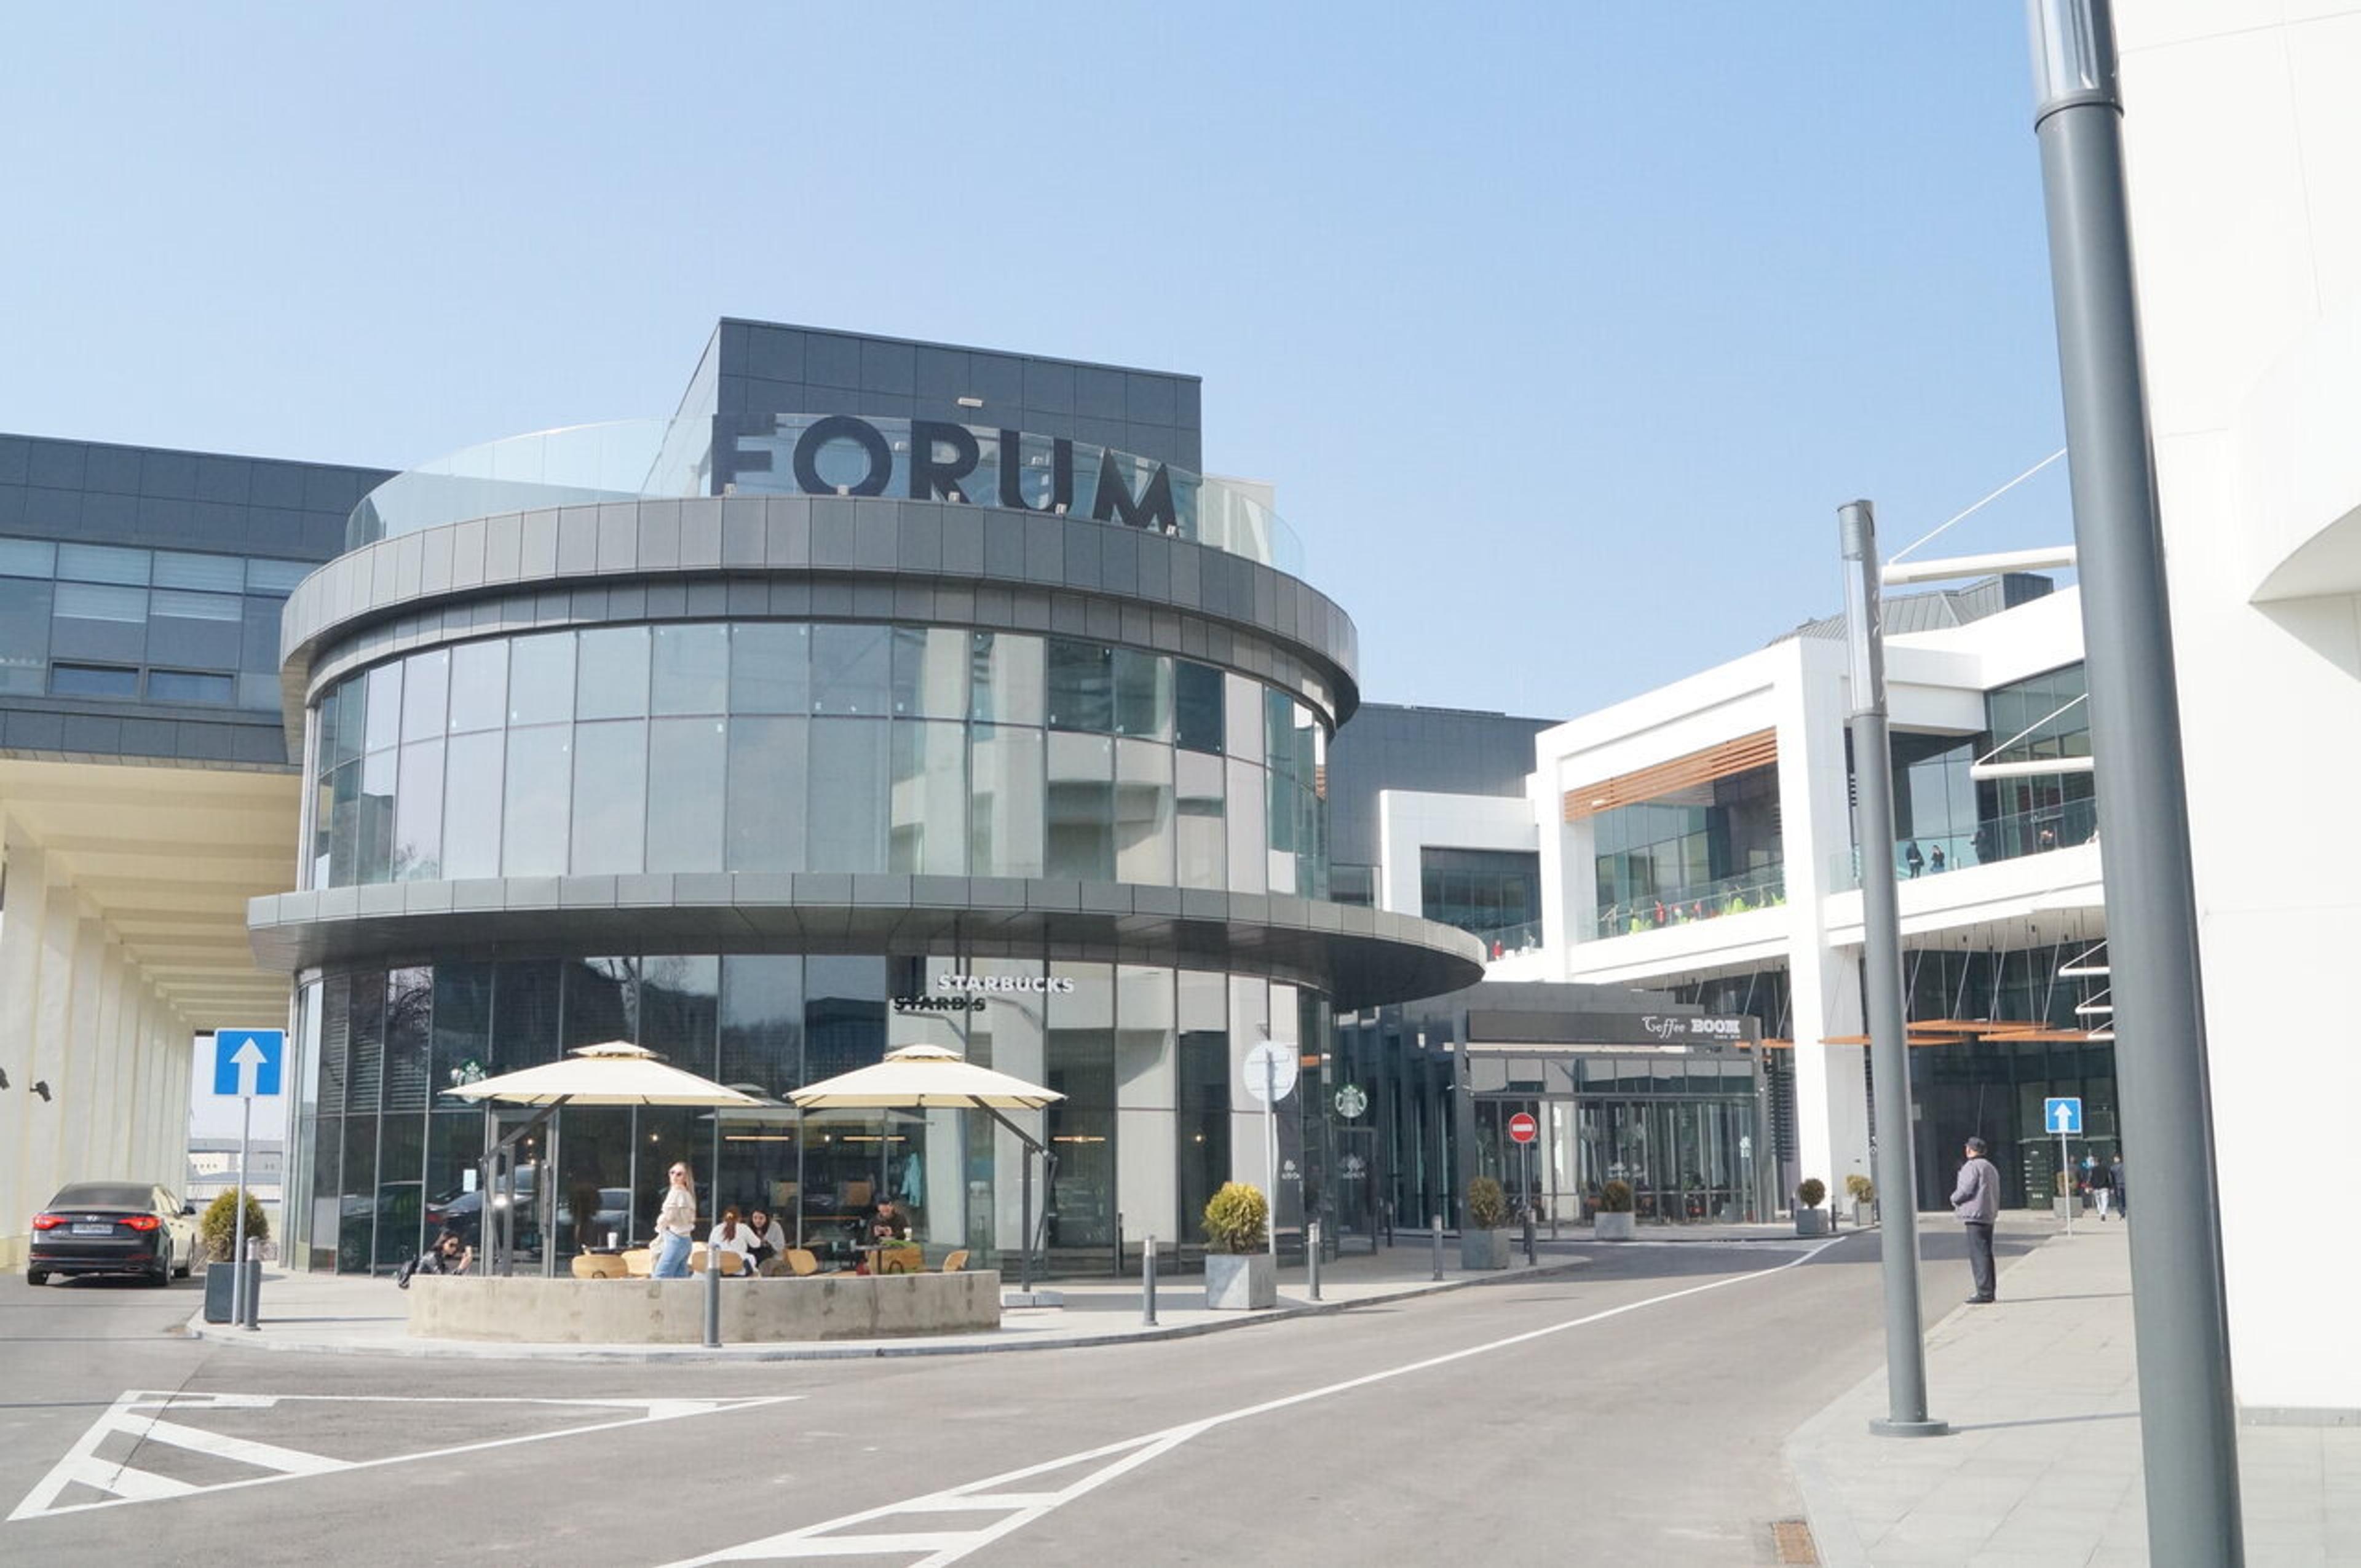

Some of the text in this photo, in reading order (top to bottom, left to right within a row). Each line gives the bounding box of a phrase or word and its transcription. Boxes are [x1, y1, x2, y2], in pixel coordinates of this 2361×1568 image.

[710, 414, 1179, 536] FORUM
[938, 974, 1075, 993] STARBUCKS
[1641, 1016, 1741, 1039] Coffee BOOM
